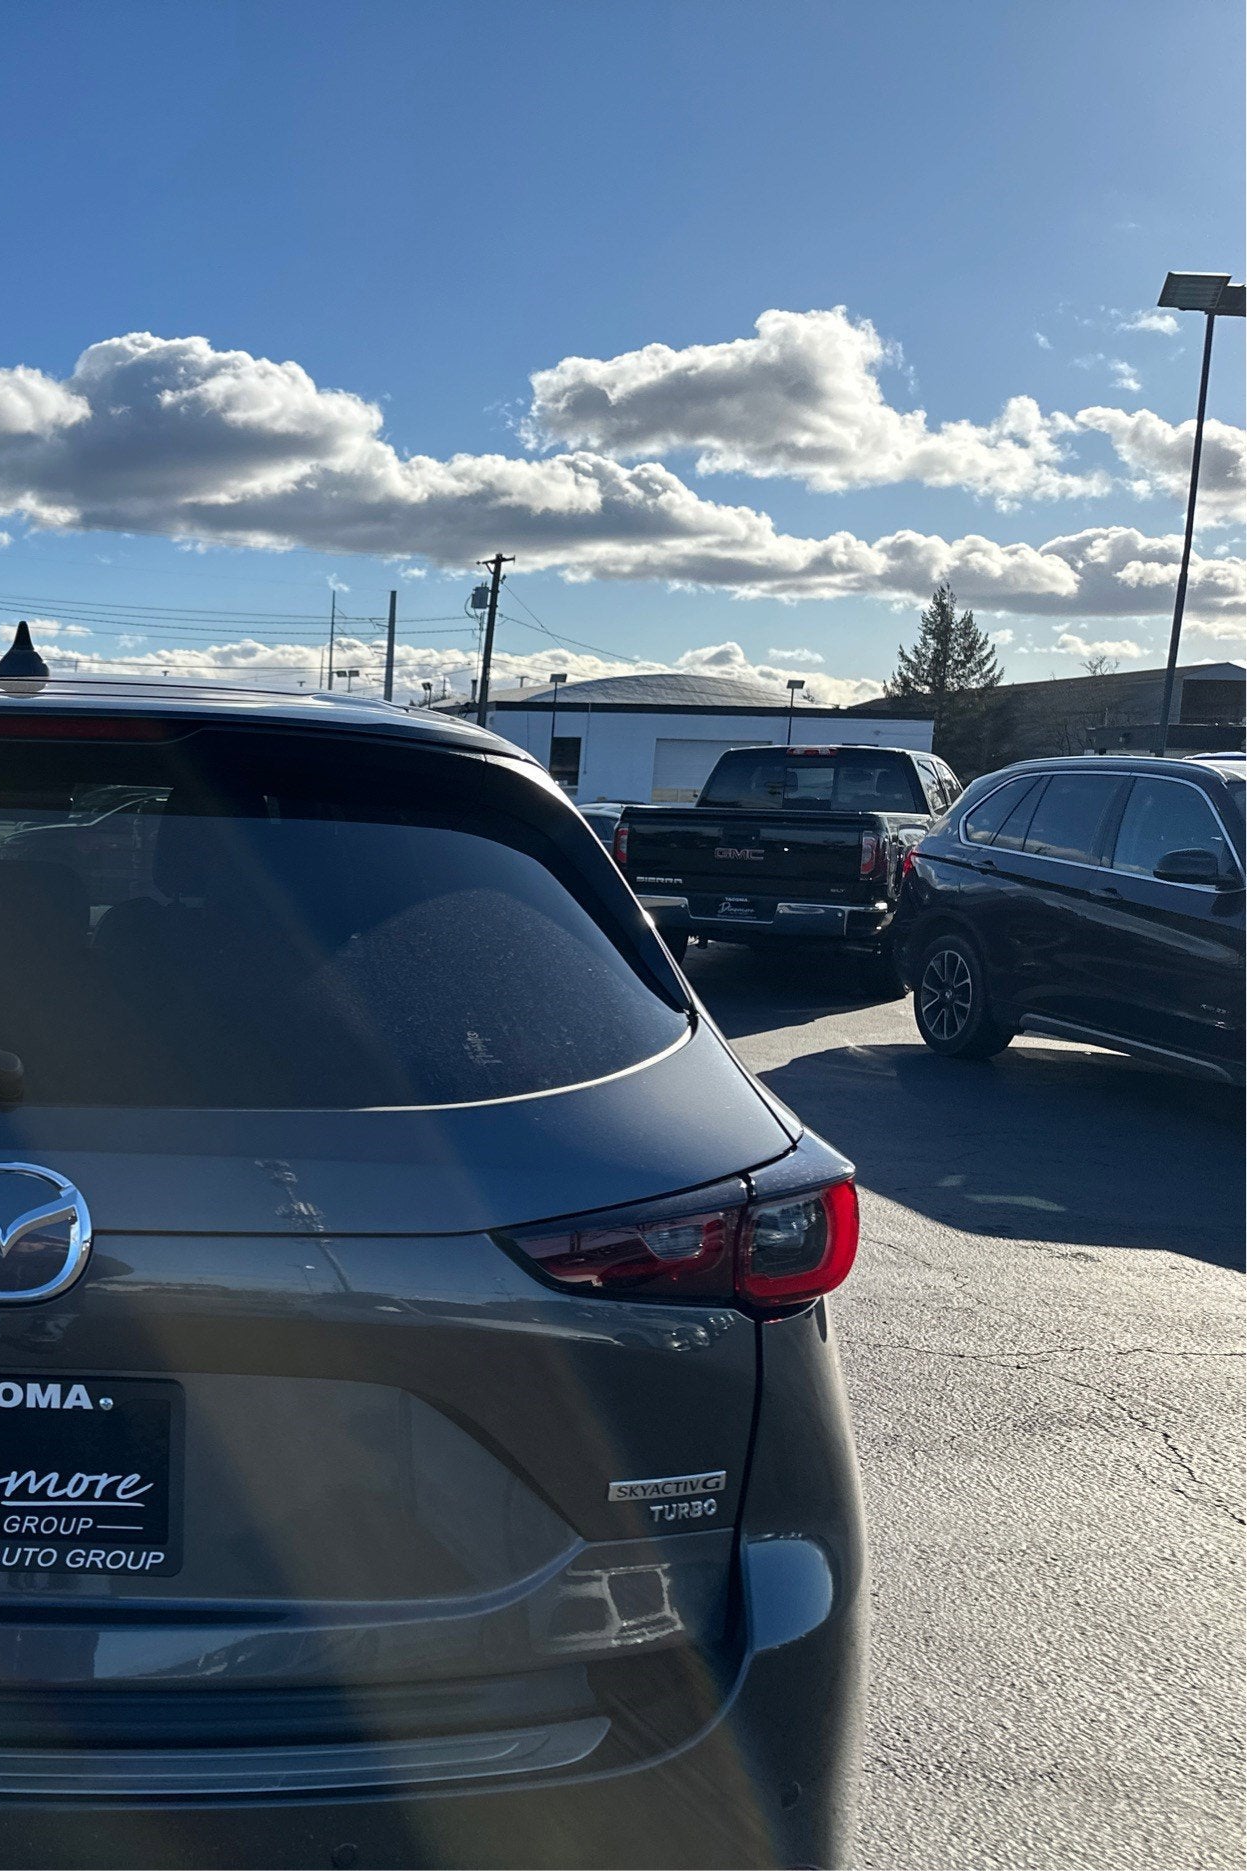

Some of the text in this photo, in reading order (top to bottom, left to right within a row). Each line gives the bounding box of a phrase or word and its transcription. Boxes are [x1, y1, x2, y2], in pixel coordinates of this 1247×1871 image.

[714, 847, 765, 861] GMC
[636, 876, 683, 884] SIERRA
[650, 1498, 718, 1522] TURBO
[3, 1515, 93, 1535] GROUP
[65, 1549, 165, 1570] GROUP
